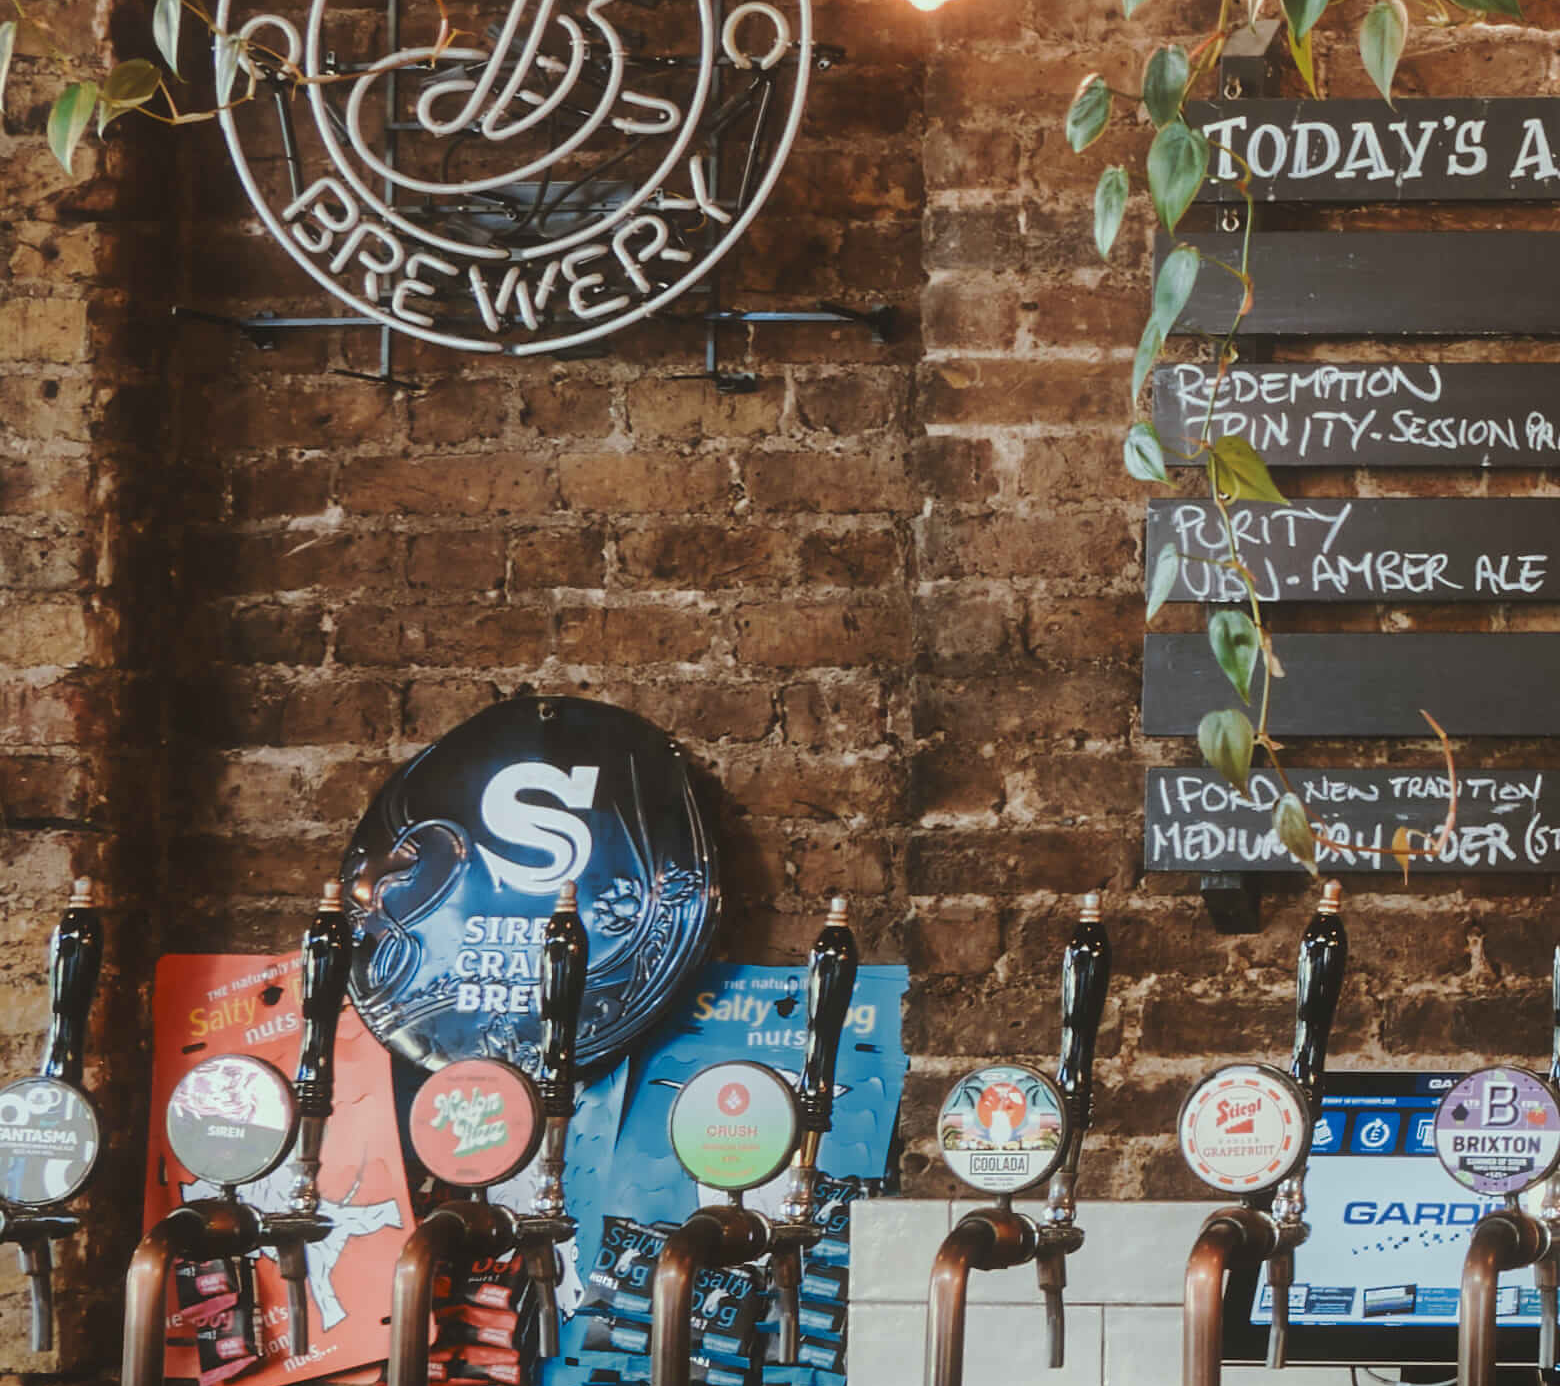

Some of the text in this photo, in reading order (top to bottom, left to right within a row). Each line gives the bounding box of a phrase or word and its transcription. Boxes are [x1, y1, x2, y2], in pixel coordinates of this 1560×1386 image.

[1203, 115, 1488, 181] TODAY'S
[283, 155, 731, 331] BREWERY
[1173, 502, 1352, 554] PURITY
[1312, 553, 1548, 595] AMBER ALE
[477, 760, 600, 895] S
[188, 995, 258, 1039] Salty
[695, 991, 772, 1027] Salty
[244, 1013, 299, 1045] nuts
[747, 1028, 808, 1047] nuts
[1214, 1097, 1262, 1128] Stiegl
[207, 1124, 246, 1140] SIREN
[705, 1125, 758, 1138] CRUSH
[1452, 1136, 1541, 1155] BRIXTON
[972, 1155, 1027, 1173] COOLADA
[1202, 1144, 1275, 1159] GRAPEFRUIT
